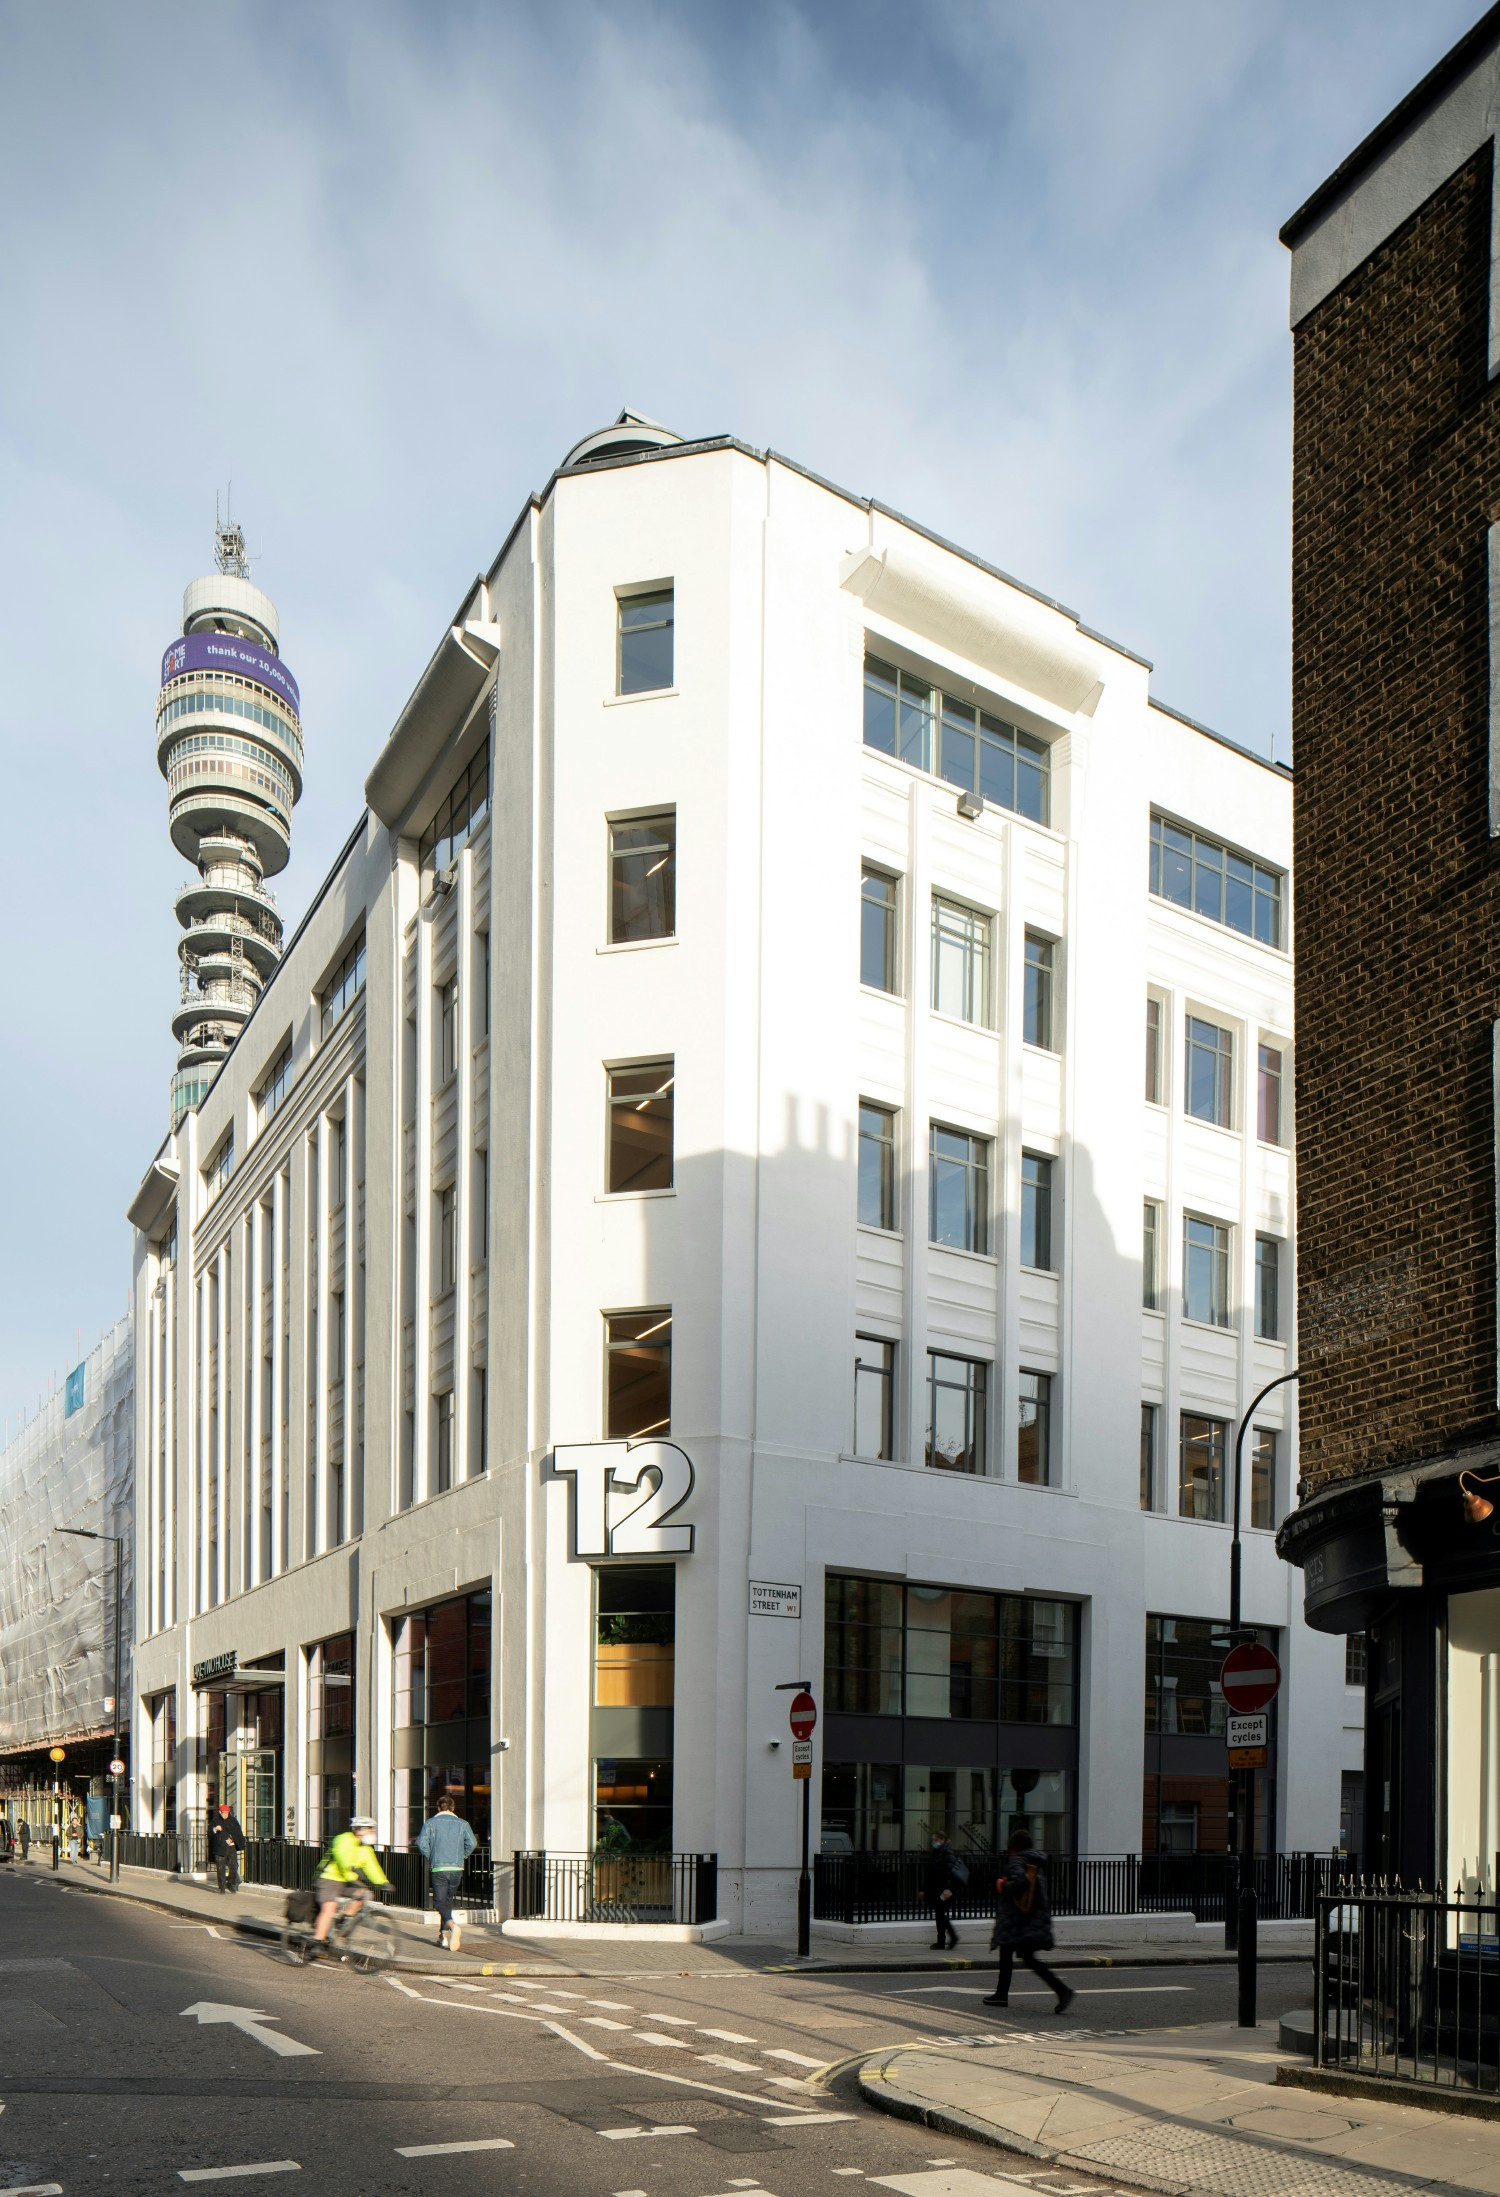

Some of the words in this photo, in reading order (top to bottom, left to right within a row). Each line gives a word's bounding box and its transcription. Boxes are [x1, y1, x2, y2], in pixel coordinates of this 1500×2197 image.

[207, 645, 237, 658] thank
[239, 651, 257, 664] our
[258, 660, 286, 686] 10,000
[553, 1440, 695, 1557] T2
[752, 1587, 798, 1600] TOTTENHAM
[752, 1600, 780, 1611] STREET
[1231, 1720, 1264, 1730] Except
[1232, 1732, 1262, 1743] cycles
[796, 1753, 810, 1761] cycles
[916, 2034, 1019, 2046] LOOK
[1005, 2029, 1107, 2044] RIGHT
